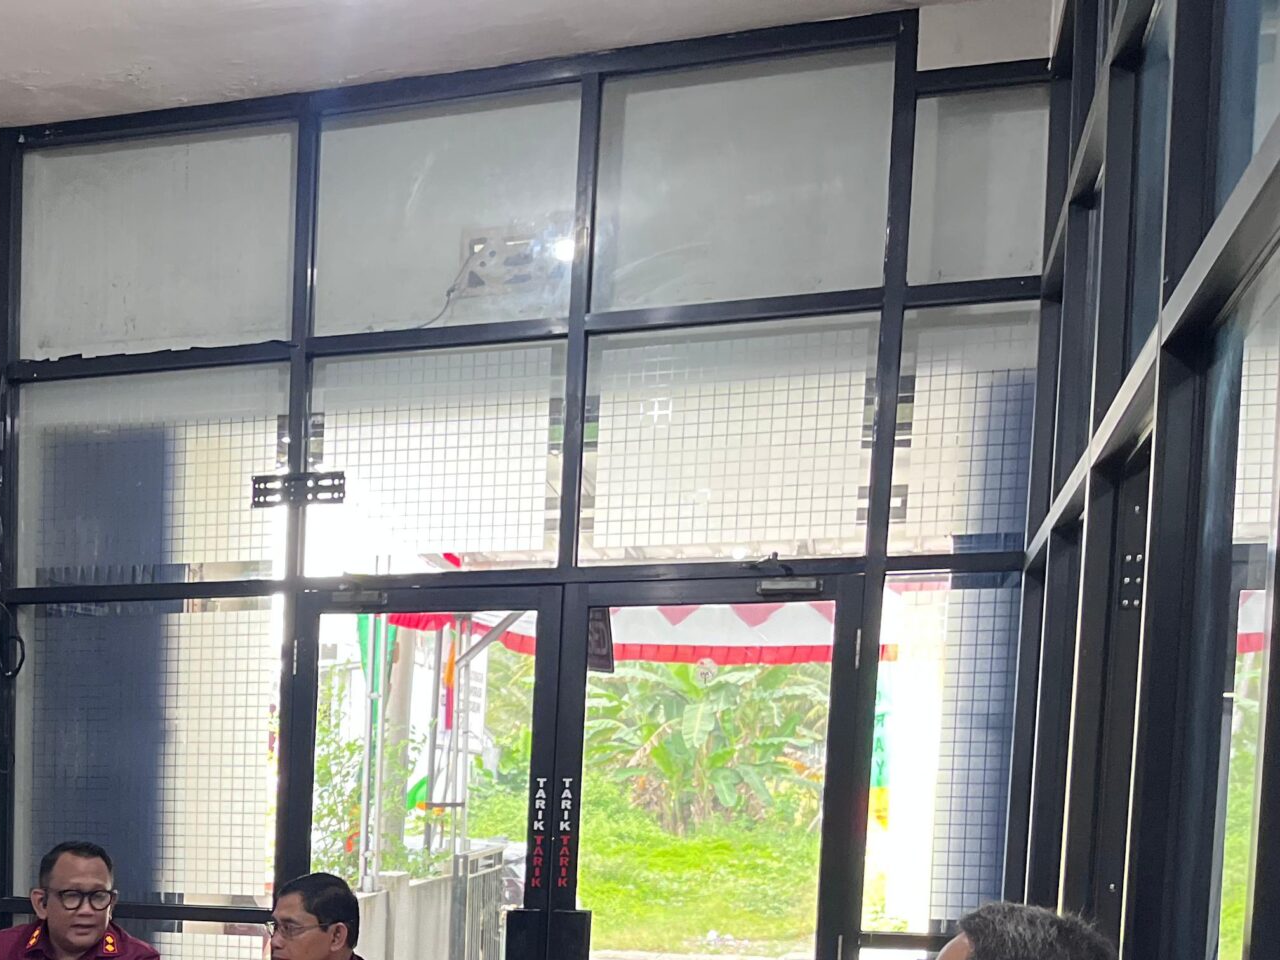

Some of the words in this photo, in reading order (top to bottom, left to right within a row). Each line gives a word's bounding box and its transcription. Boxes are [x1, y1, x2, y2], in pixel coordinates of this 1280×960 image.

[533, 778, 547, 831] TARIK
[559, 778, 573, 831] TARIK
[531, 835, 544, 888] TARIK
[557, 835, 570, 888] TARIK
